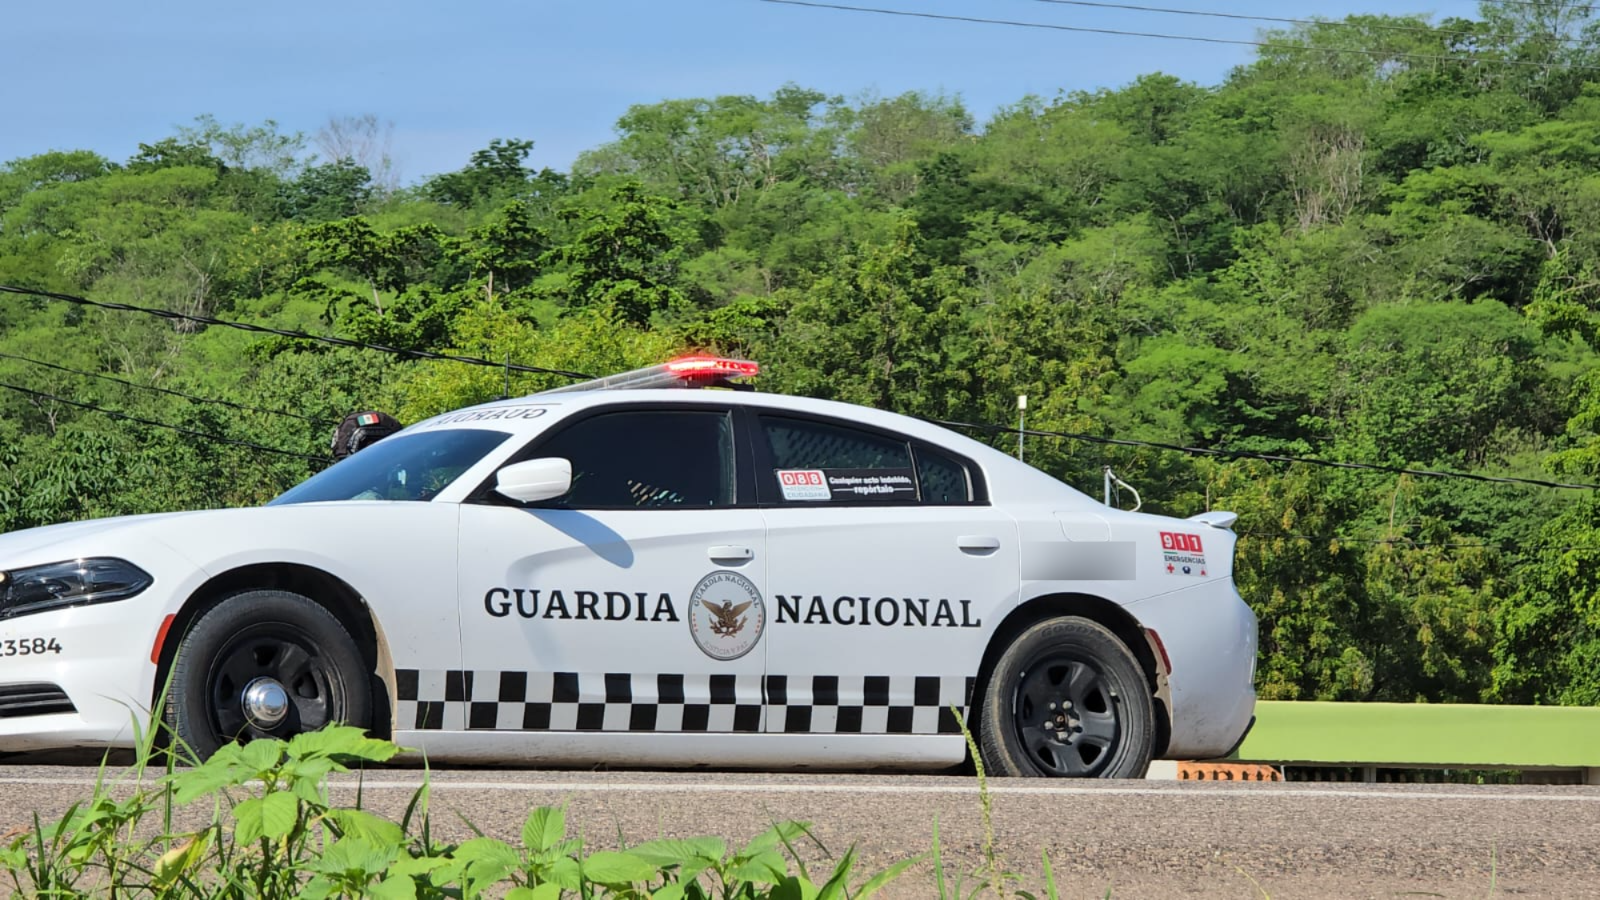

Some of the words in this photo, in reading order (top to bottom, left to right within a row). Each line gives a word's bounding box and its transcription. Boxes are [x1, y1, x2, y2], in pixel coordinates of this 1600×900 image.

[782, 472, 821, 485] 088
[828, 476, 862, 486] Cualquier
[863, 476, 879, 485] acto
[1161, 533, 1200, 550] 911
[1164, 555, 1206, 564] EMERGENCIAS
[694, 575, 724, 608] GUARDIA
[724, 575, 760, 609] NACIONAL
[484, 587, 680, 622] GUARDIA
[774, 595, 982, 628] NACIONAL
[0, 637, 63, 657] 3584
